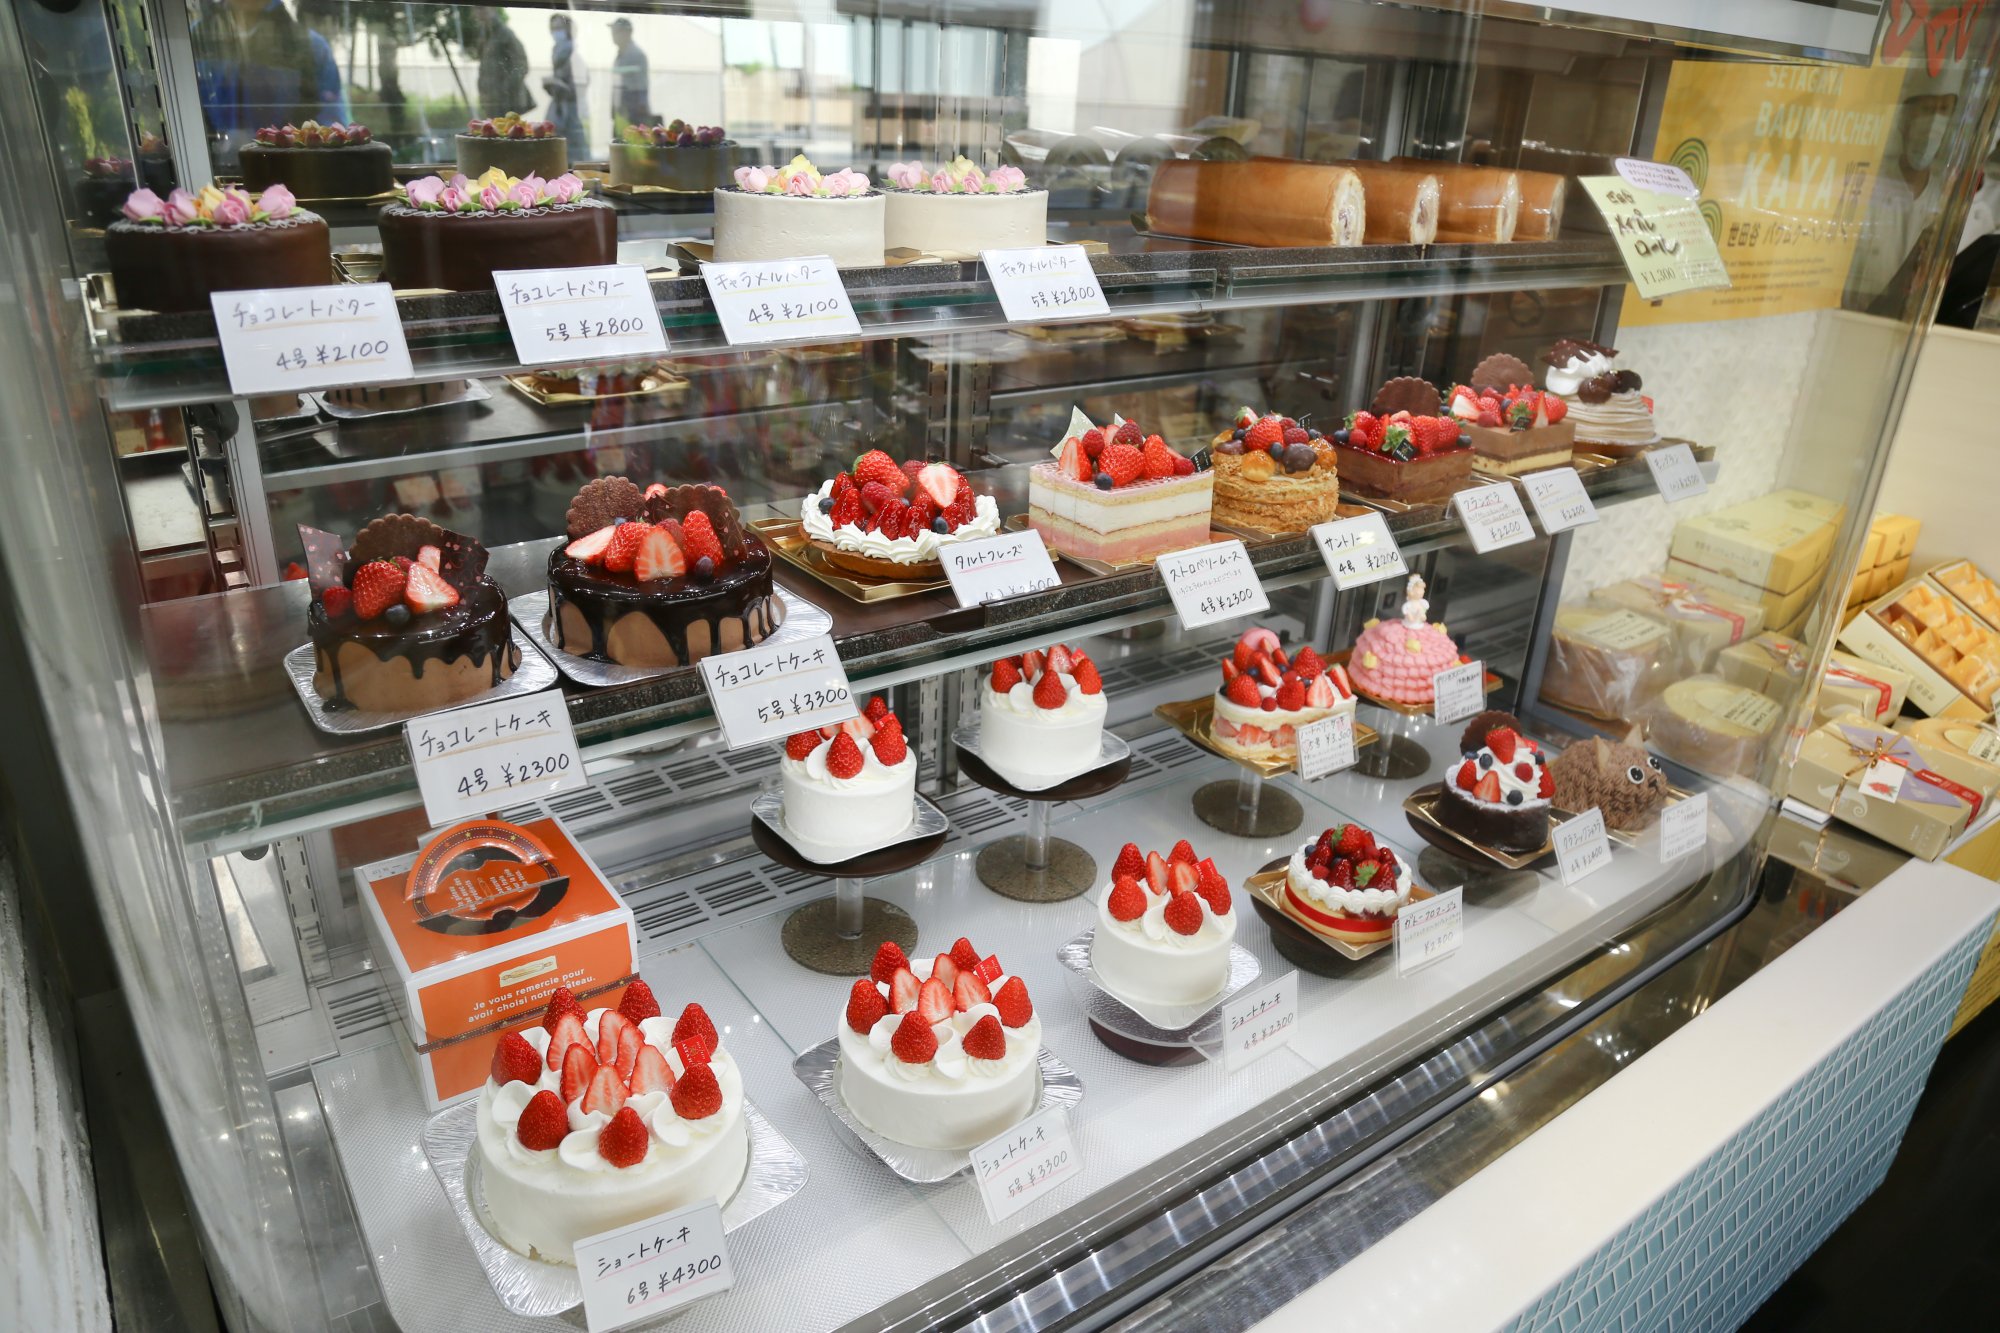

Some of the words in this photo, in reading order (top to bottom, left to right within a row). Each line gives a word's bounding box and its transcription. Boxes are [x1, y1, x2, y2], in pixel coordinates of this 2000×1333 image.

[1754, 101, 1883, 145] BAUMKUCHEN
[1738, 150, 1837, 209] KAYA
[510, 280, 624, 304] チョコレートバター
[749, 303, 774, 323] 4号
[782, 298, 838, 319] ¥2100
[1031, 291, 1048, 308] 5号
[1051, 286, 1095, 306] ¥2800
[233, 299, 376, 327] チョコレートバター
[546, 323, 570, 341] 5号
[580, 317, 643, 338] ¥2800
[276, 348, 307, 369] 4号
[316, 340, 388, 364] ¥2100
[955, 543, 1024, 570] タルトフレーズ
[1169, 550, 1243, 583] ストロベリームース
[1339, 559, 1356, 575] 4号
[1365, 551, 1399, 571] ¥2200
[1201, 596, 1216, 615] 4号
[1216, 588, 1253, 612] ¥2300
[715, 648, 825, 687] チョコレートケーキ
[757, 700, 785, 723] 5号
[790, 687, 848, 714] ¥3300
[419, 709, 552, 757] チョコレートケーキ
[457, 767, 489, 797] 4号
[501, 752, 570, 788] ¥2300
[468, 1008, 494, 1023] avoir
[496, 997, 528, 1013] choisi
[530, 987, 557, 1001] notre
[473, 1001, 486, 1011] Je
[488, 992, 513, 1004] vous
[515, 976, 560, 996] remercie
[562, 968, 585, 981] pour
[1231, 992, 1281, 1032] ショートケーキ
[1244, 1032, 1258, 1050] 4号
[1262, 1012, 1294, 1041] ¥2300
[981, 1126, 1045, 1177] ショートケーキ
[1008, 1178, 1023, 1197] 5号
[1027, 1150, 1068, 1186] ¥3300
[598, 1226, 690, 1278] ショートケーキ
[627, 1281, 649, 1305] 6号
[658, 1254, 722, 1293] ¥4300
